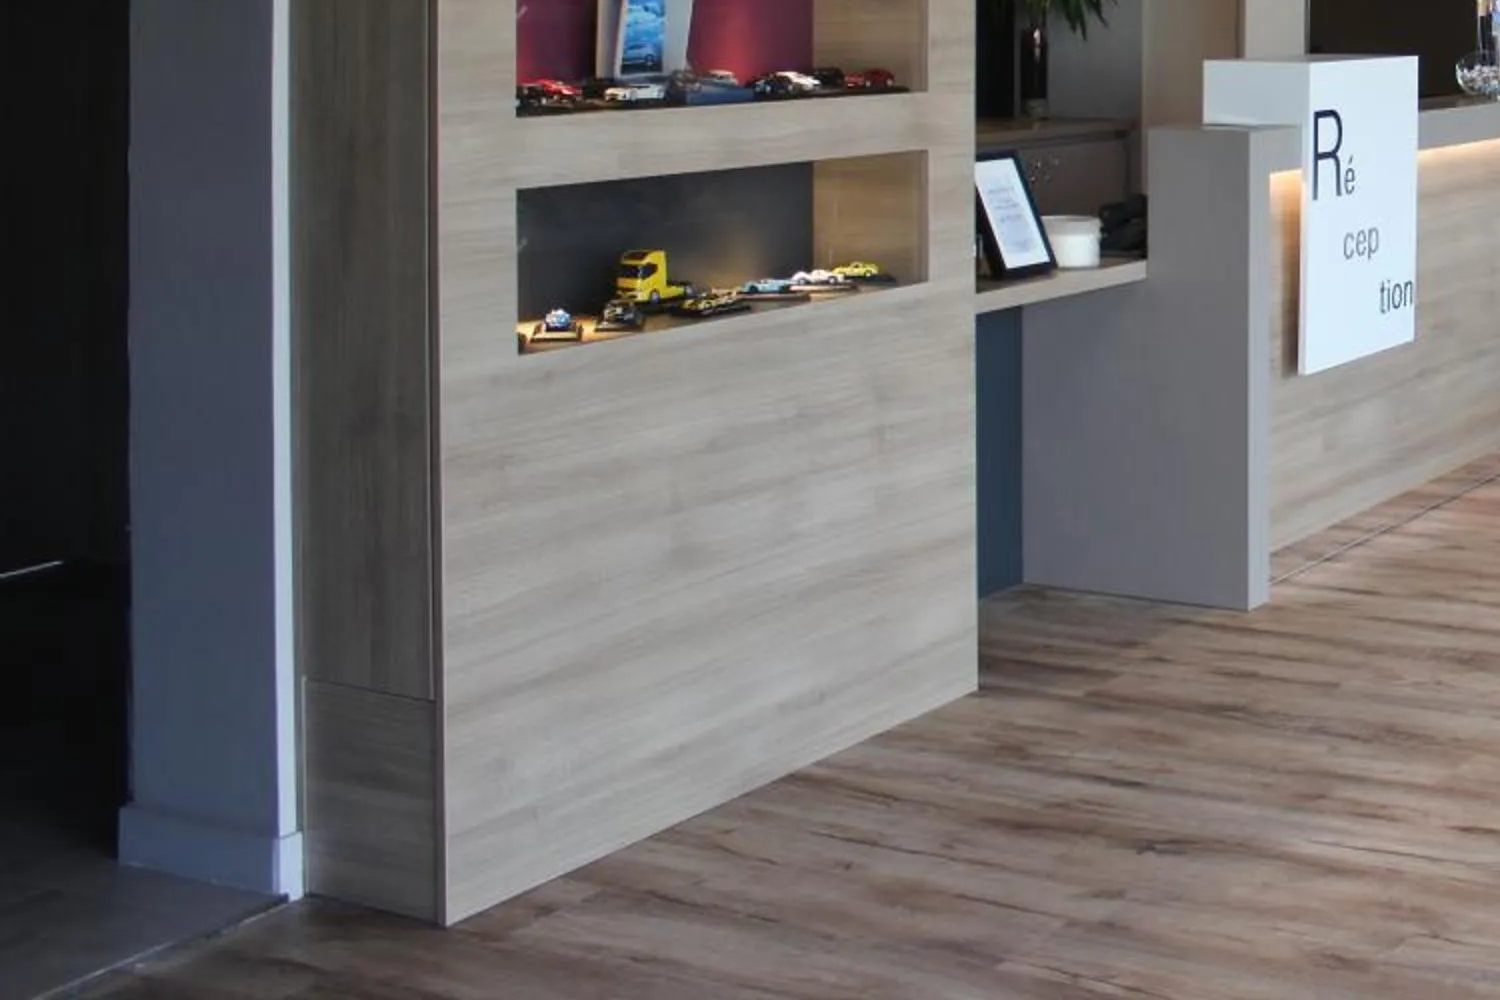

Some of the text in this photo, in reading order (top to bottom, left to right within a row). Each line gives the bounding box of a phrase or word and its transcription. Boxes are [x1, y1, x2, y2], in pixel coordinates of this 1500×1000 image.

[1312, 109, 1356, 201] Ré
[1343, 226, 1380, 261] cep
[1379, 279, 1414, 314] tion
